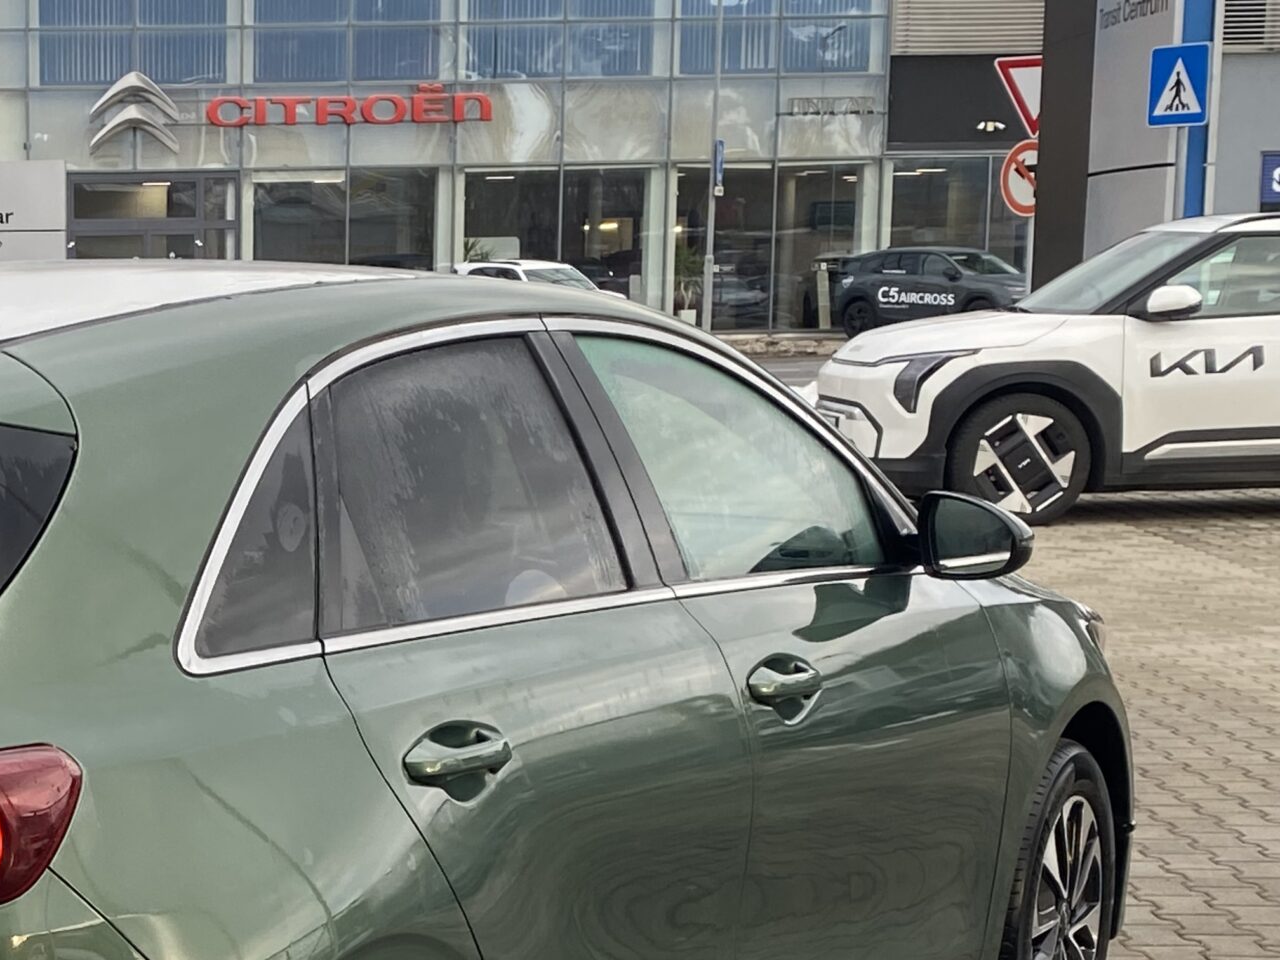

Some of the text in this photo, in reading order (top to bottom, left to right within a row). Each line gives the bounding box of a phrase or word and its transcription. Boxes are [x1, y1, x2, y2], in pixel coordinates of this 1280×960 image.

[878, 286, 955, 306] C5 AIRCROSS
[1149, 345, 1264, 377] KIA
